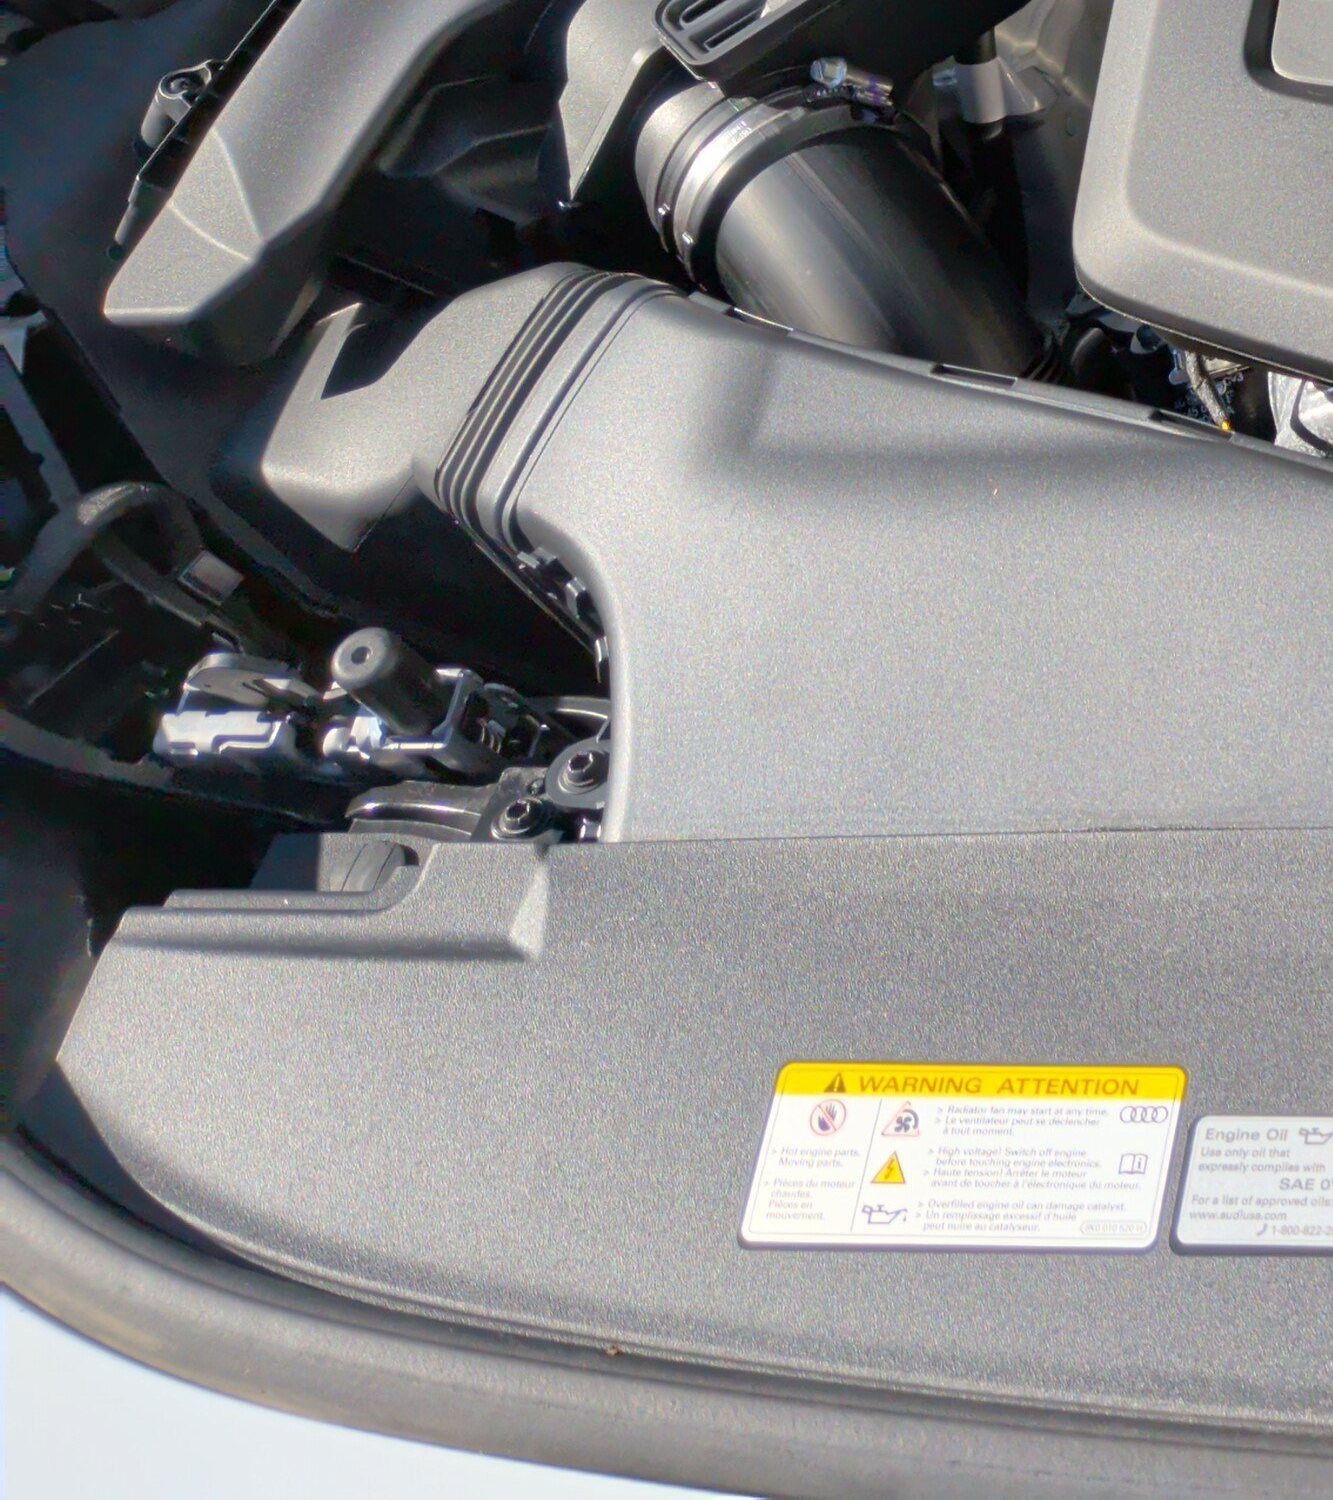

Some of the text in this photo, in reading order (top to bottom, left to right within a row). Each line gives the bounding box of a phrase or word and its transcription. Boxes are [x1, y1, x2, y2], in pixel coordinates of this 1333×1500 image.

[859, 1075, 1139, 1096] WARNING ATTENTION
[948, 1104, 987, 1114] Radiator
[1008, 1107, 1027, 1116] may
[1031, 1108, 1052, 1116] start
[1066, 1108, 1082, 1117] any
[945, 1116, 956, 1124] Le
[960, 1116, 1008, 1125] ventilateur
[1011, 1118, 1033, 1127] peut
[951, 1127, 970, 1135] tout
[1205, 1128, 1288, 1143] Engine Oil
[781, 1146, 798, 1155] Hot
[800, 1148, 832, 1158] engine
[938, 1146, 960, 1157] High
[1004, 1147, 1036, 1156] Switch
[1038, 1148, 1054, 1157] off
[1054, 1149, 1087, 1159] engine
[1200, 1147, 1290, 1160] Use only oil that
[778, 1157, 815, 1168] Moving
[936, 1158, 966, 1166] before
[969, 1158, 1010, 1168] touching
[1013, 1160, 1046, 1169] engine
[1198, 1162, 1326, 1174] expressly complies with
[934, 1168, 961, 1176] Haute
[1052, 1170, 1088, 1178] moteur
[805, 1178, 818, 1188] du
[820, 1180, 855, 1188] moteur
[931, 1180, 958, 1188] avant
[960, 1179, 972, 1188] de
[974, 1180, 1011, 1188] toucher
[1279, 1178, 1316, 1191] SAE
[928, 1199, 975, 1209] Overfilled
[977, 1201, 1009, 1210] engine
[1011, 1200, 1024, 1209] oil
[1046, 1202, 1085, 1212] damage
[1192, 1194, 1333, 1209] For a list of approved oils:
[942, 1211, 1000, 1222] remplissage
[1189, 1211, 1287, 1221] www.audiusa.com
[923, 1222, 945, 1232] peut
